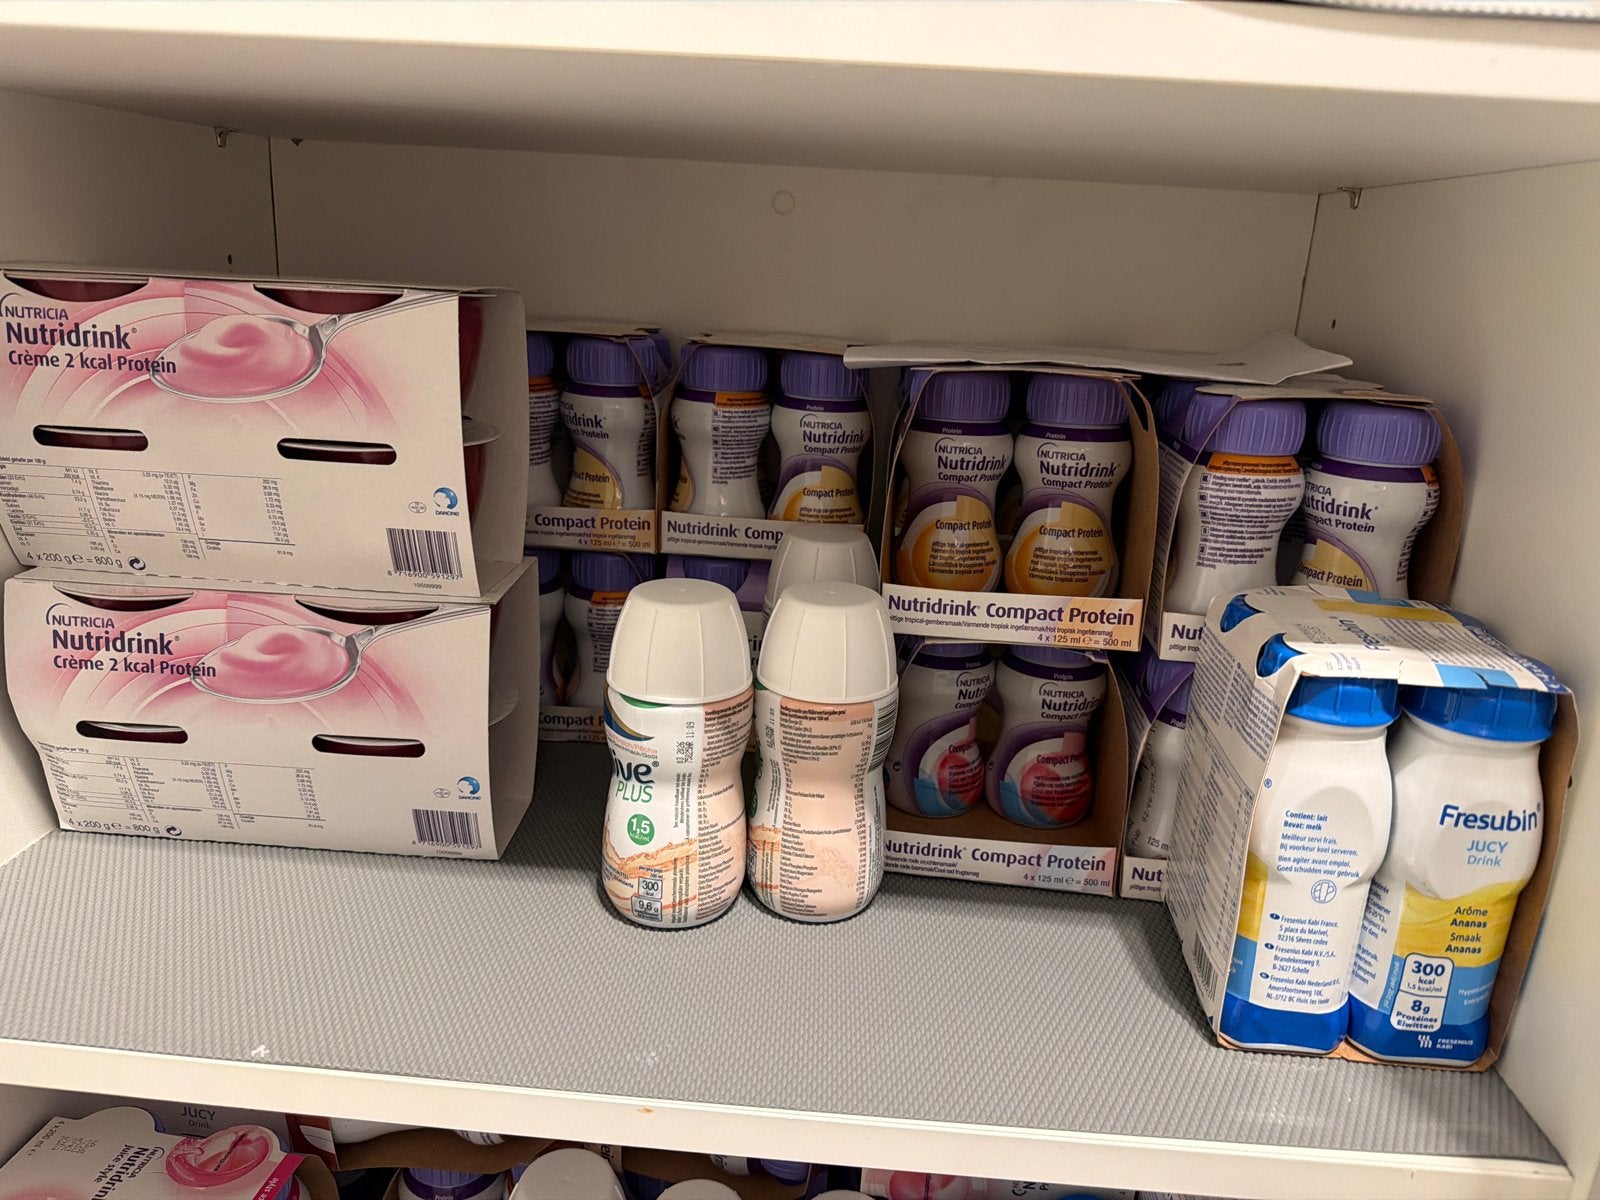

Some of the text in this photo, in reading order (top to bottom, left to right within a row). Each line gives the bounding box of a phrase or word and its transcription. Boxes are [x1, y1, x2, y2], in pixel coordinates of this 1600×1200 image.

[5, 306, 69, 320] NUTRICIA
[9, 350, 176, 373] Crème 2 kcal Protein
[803, 421, 843, 430] NUTRICIA
[1045, 432, 1066, 440] Protein
[804, 445, 839, 456] Compact
[938, 446, 983, 455] NUTRICIA
[1041, 452, 1086, 461] NUTRICIA
[938, 455, 1005, 471] Nutridrink
[1040, 460, 1116, 477] Nutridrink
[938, 472, 978, 483] Compact
[1042, 478, 1113, 490] Compact Protein
[803, 488, 834, 500] Compact
[536, 514, 651, 531] Compact Protein
[936, 519, 971, 533] Compact
[1335, 519, 1375, 533] Protein
[667, 520, 738, 538] Nutridrink
[1039, 525, 1104, 540] Compact Protein
[44, 552, 62, 562] 200
[94, 555, 113, 566] 800
[1327, 572, 1363, 588] Protein
[888, 595, 1134, 626] Nutridrink Compact Protein
[52, 614, 115, 629] NUTRICIA
[1038, 634, 1043, 642] 4
[1053, 635, 1068, 643] 125
[1070, 636, 1081, 644] ml
[1103, 638, 1119, 647] 500
[1121, 638, 1132, 647] ml
[54, 655, 216, 677] Crème 2 kcal Protein
[1042, 689, 1084, 699] NUTRICIA
[1041, 712, 1077, 722] Compact
[1037, 754, 1068, 766] Compact
[616, 781, 653, 803] PLUS
[1286, 810, 1328, 822] Contient: lait
[1440, 804, 1537, 832] Fresubin
[85, 821, 101, 829] 200
[631, 817, 650, 834] 1,5
[1283, 821, 1322, 831] Bevat: melk
[1281, 833, 1306, 842] Meilleur
[1323, 836, 1338, 845] frais.
[1280, 843, 1358, 857] Bij voorkeur koel serveren.
[1466, 840, 1508, 853] JUCY
[972, 848, 1041, 868] Compact
[1048, 851, 1106, 871] Protein
[1278, 855, 1291, 863] Bien
[1292, 856, 1310, 865] agiter
[1329, 859, 1351, 868] emploi.
[1467, 855, 1501, 866] Drink
[1277, 865, 1292, 873] Goed
[1294, 865, 1321, 874] schudden
[642, 880, 659, 892] 300
[1038, 874, 1051, 883] 125
[1053, 875, 1064, 884] ml
[1083, 878, 1099, 887] 500
[1100, 878, 1110, 887] ml
[638, 900, 652, 912] 9,6
[1454, 906, 1488, 916] Arôme
[1281, 916, 1306, 925] Fresenius
[1307, 918, 1319, 926] Kabi
[1450, 918, 1487, 928] Ananas
[1284, 926, 1298, 935] place
[1450, 932, 1481, 943] Smaak
[1275, 945, 1301, 955] Fresenius
[1302, 948, 1313, 956] Kabi
[1445, 944, 1482, 954] Ananas
[1411, 960, 1445, 977] 300
[1270, 975, 1295, 985] Fresenius
[1296, 977, 1307, 986] Kabi
[1418, 977, 1435, 985] kcal
[1411, 1000, 1430, 1014] 8 g
[182, 1106, 216, 1120] JUCY
